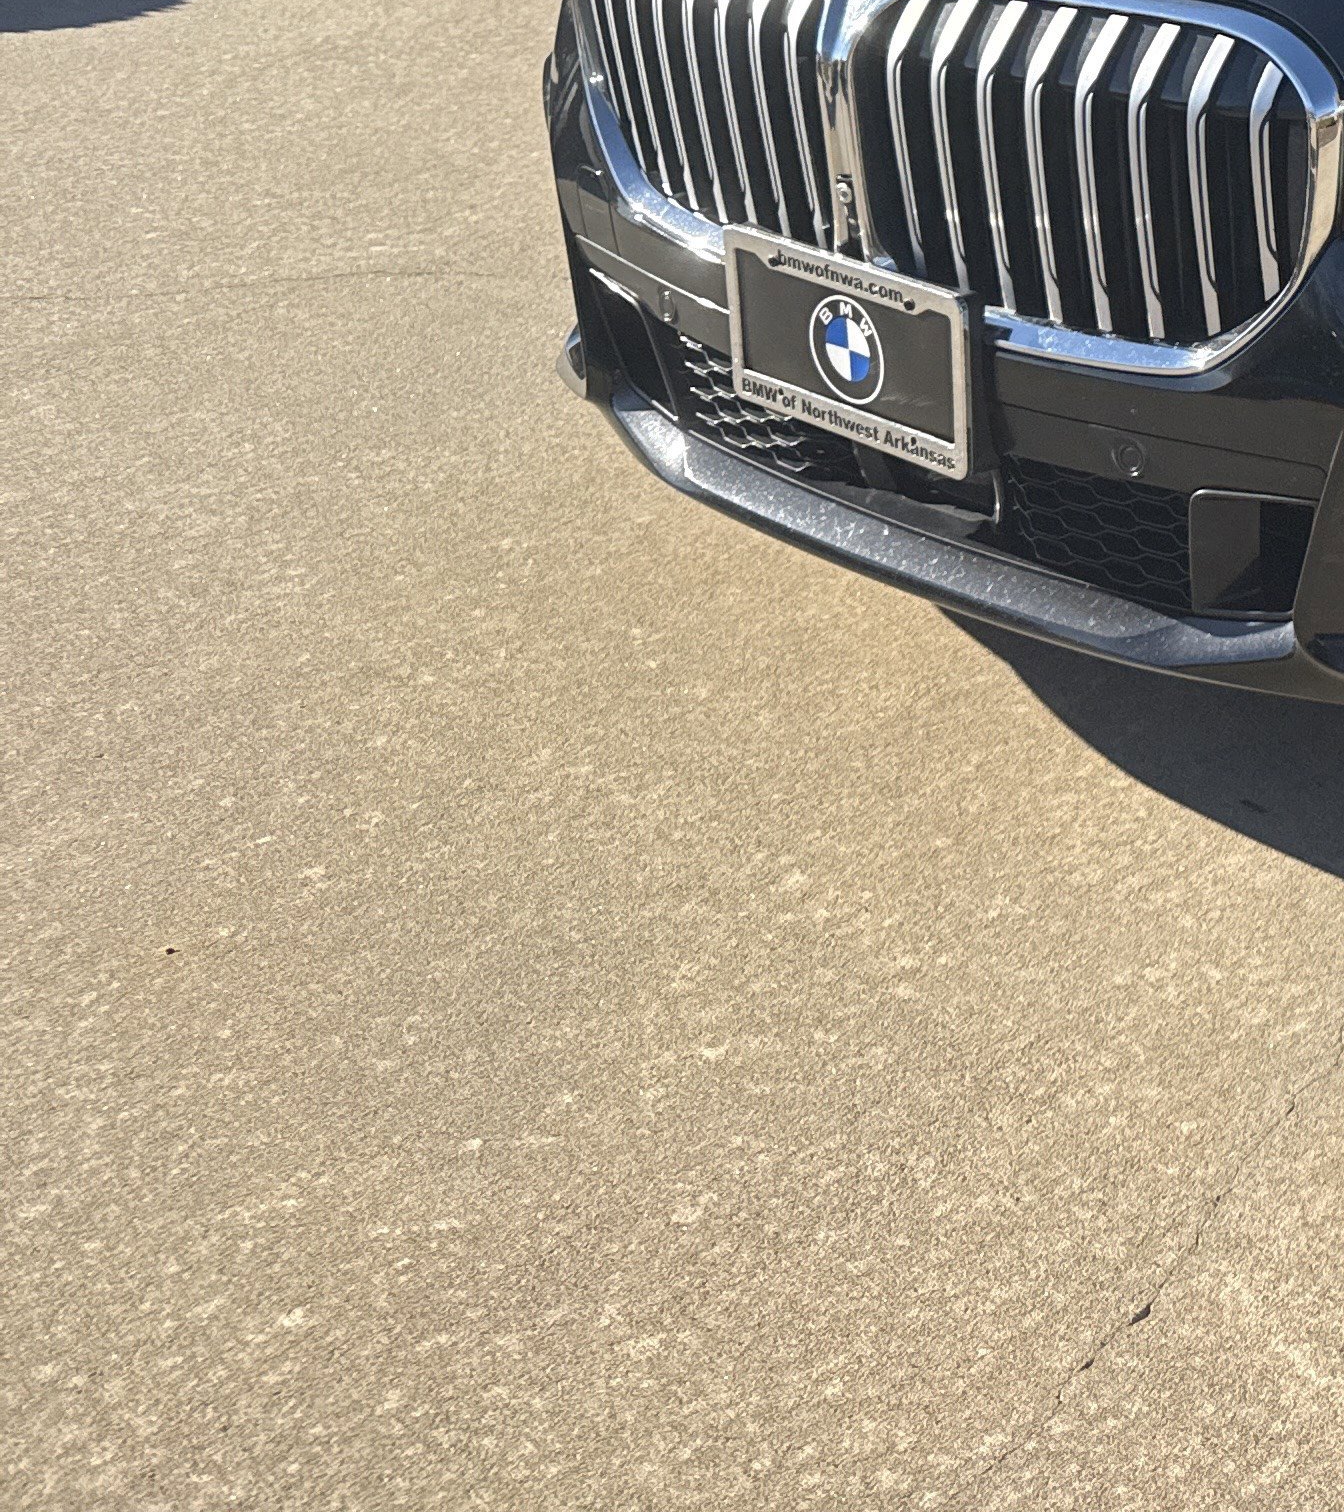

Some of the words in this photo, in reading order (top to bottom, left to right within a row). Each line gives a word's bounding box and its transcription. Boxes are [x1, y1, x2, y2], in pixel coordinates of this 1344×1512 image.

[777, 248, 904, 304] bmwofnwa.com
[818, 301, 873, 338] BMW
[741, 377, 778, 404] BMW
[782, 396, 797, 408] of
[801, 402, 879, 441] Northwest
[883, 429, 957, 471] Arkansas
